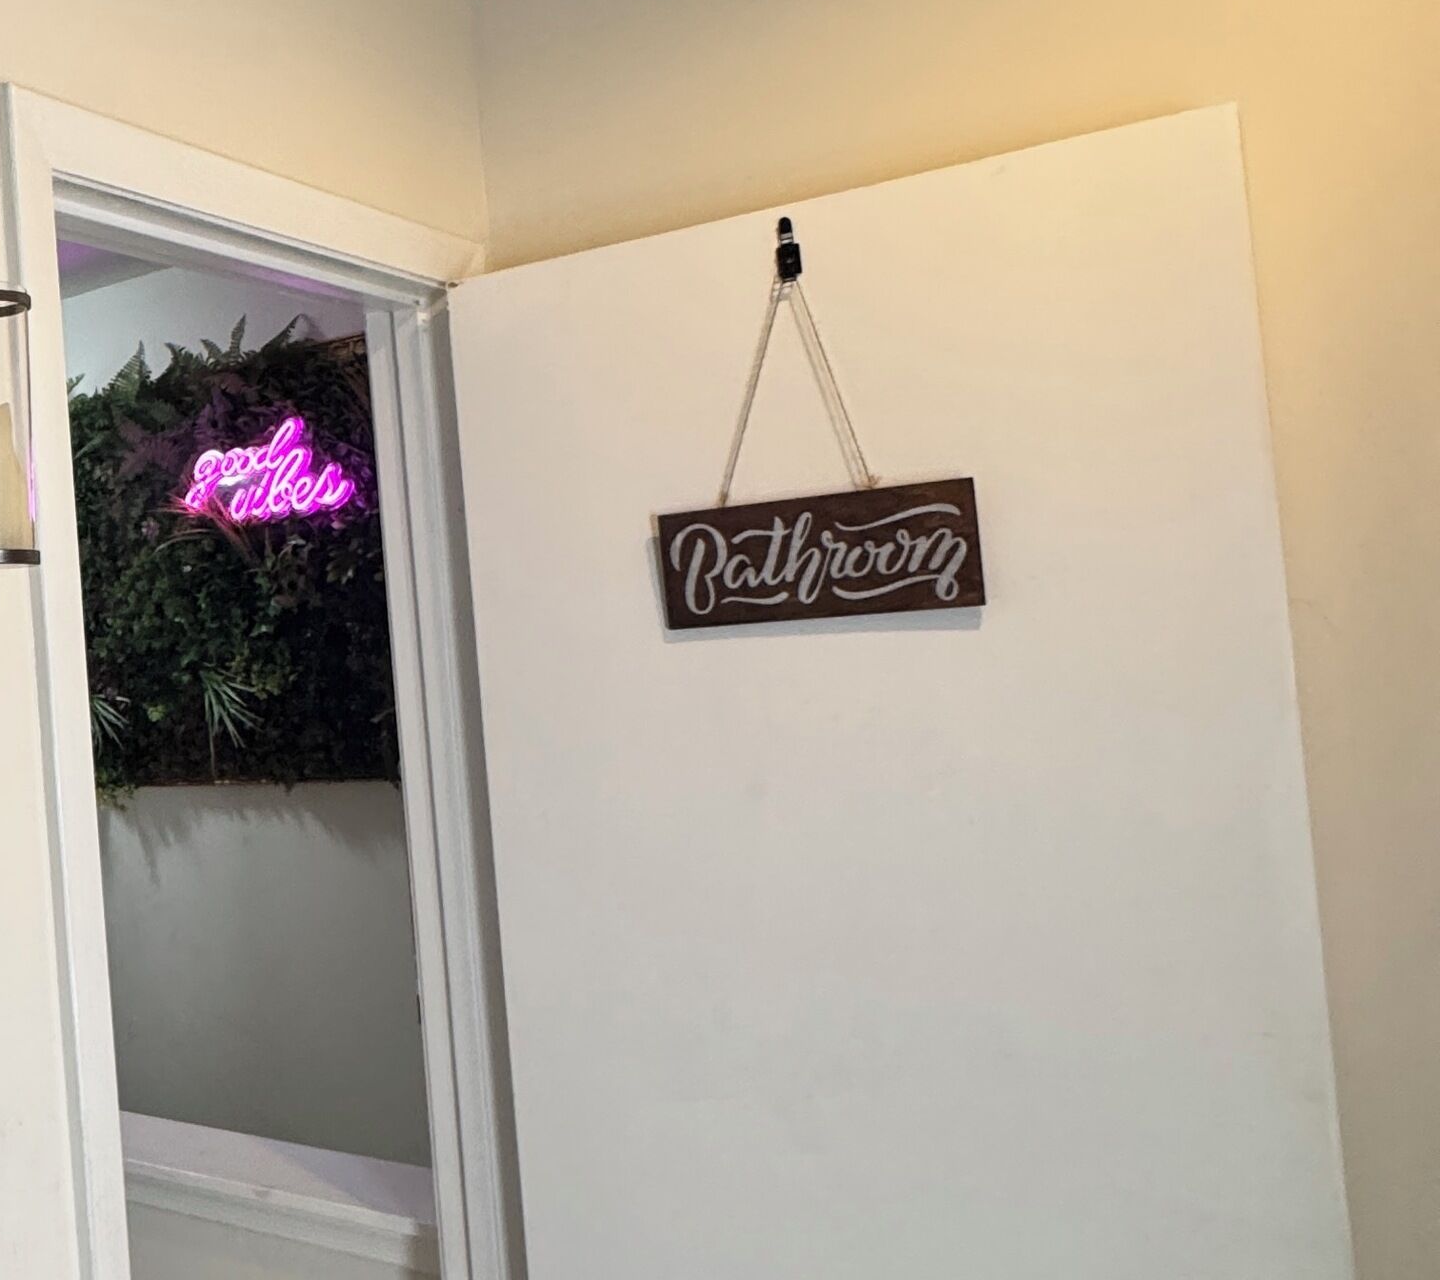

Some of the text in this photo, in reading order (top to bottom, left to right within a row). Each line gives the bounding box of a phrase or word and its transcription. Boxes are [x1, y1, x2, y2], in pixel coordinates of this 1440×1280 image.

[185, 418, 303, 508] good
[230, 448, 355, 520] vibes
[669, 510, 968, 615] Bathroom
